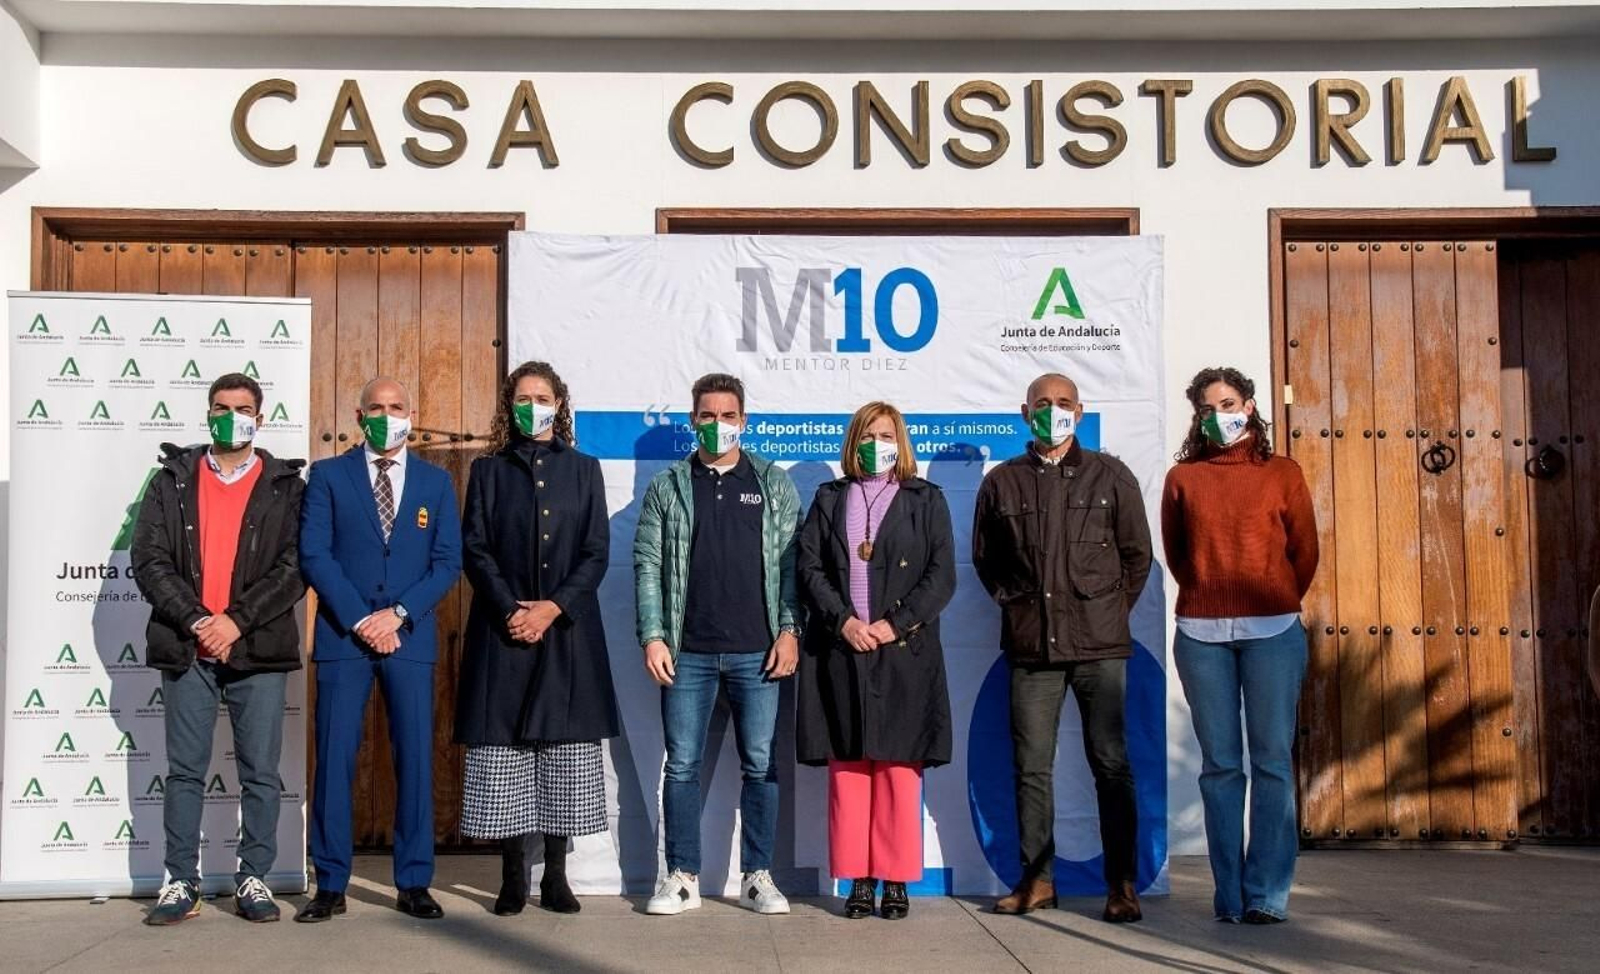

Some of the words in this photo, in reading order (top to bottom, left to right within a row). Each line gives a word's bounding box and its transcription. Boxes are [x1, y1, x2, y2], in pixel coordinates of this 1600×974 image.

[231, 78, 560, 169] CASA
[668, 76, 1557, 168] CONSISTORIAL
[735, 267, 939, 353] M10
[1000, 326, 1036, 338] Junta
[1040, 325, 1056, 337] de
[1058, 324, 1121, 337] Andalucía
[765, 358, 850, 371] MENTOR
[862, 358, 909, 371] DIEZ
[756, 420, 844, 438] deportistas
[932, 424, 940, 435] a
[944, 420, 956, 435] sí
[958, 422, 1018, 435] mismos.
[674, 440, 697, 452] Los
[760, 440, 840, 456] deportistas
[56, 562, 118, 580] Junta
[56, 590, 120, 605] Consejería
[122, 590, 138, 602] de
